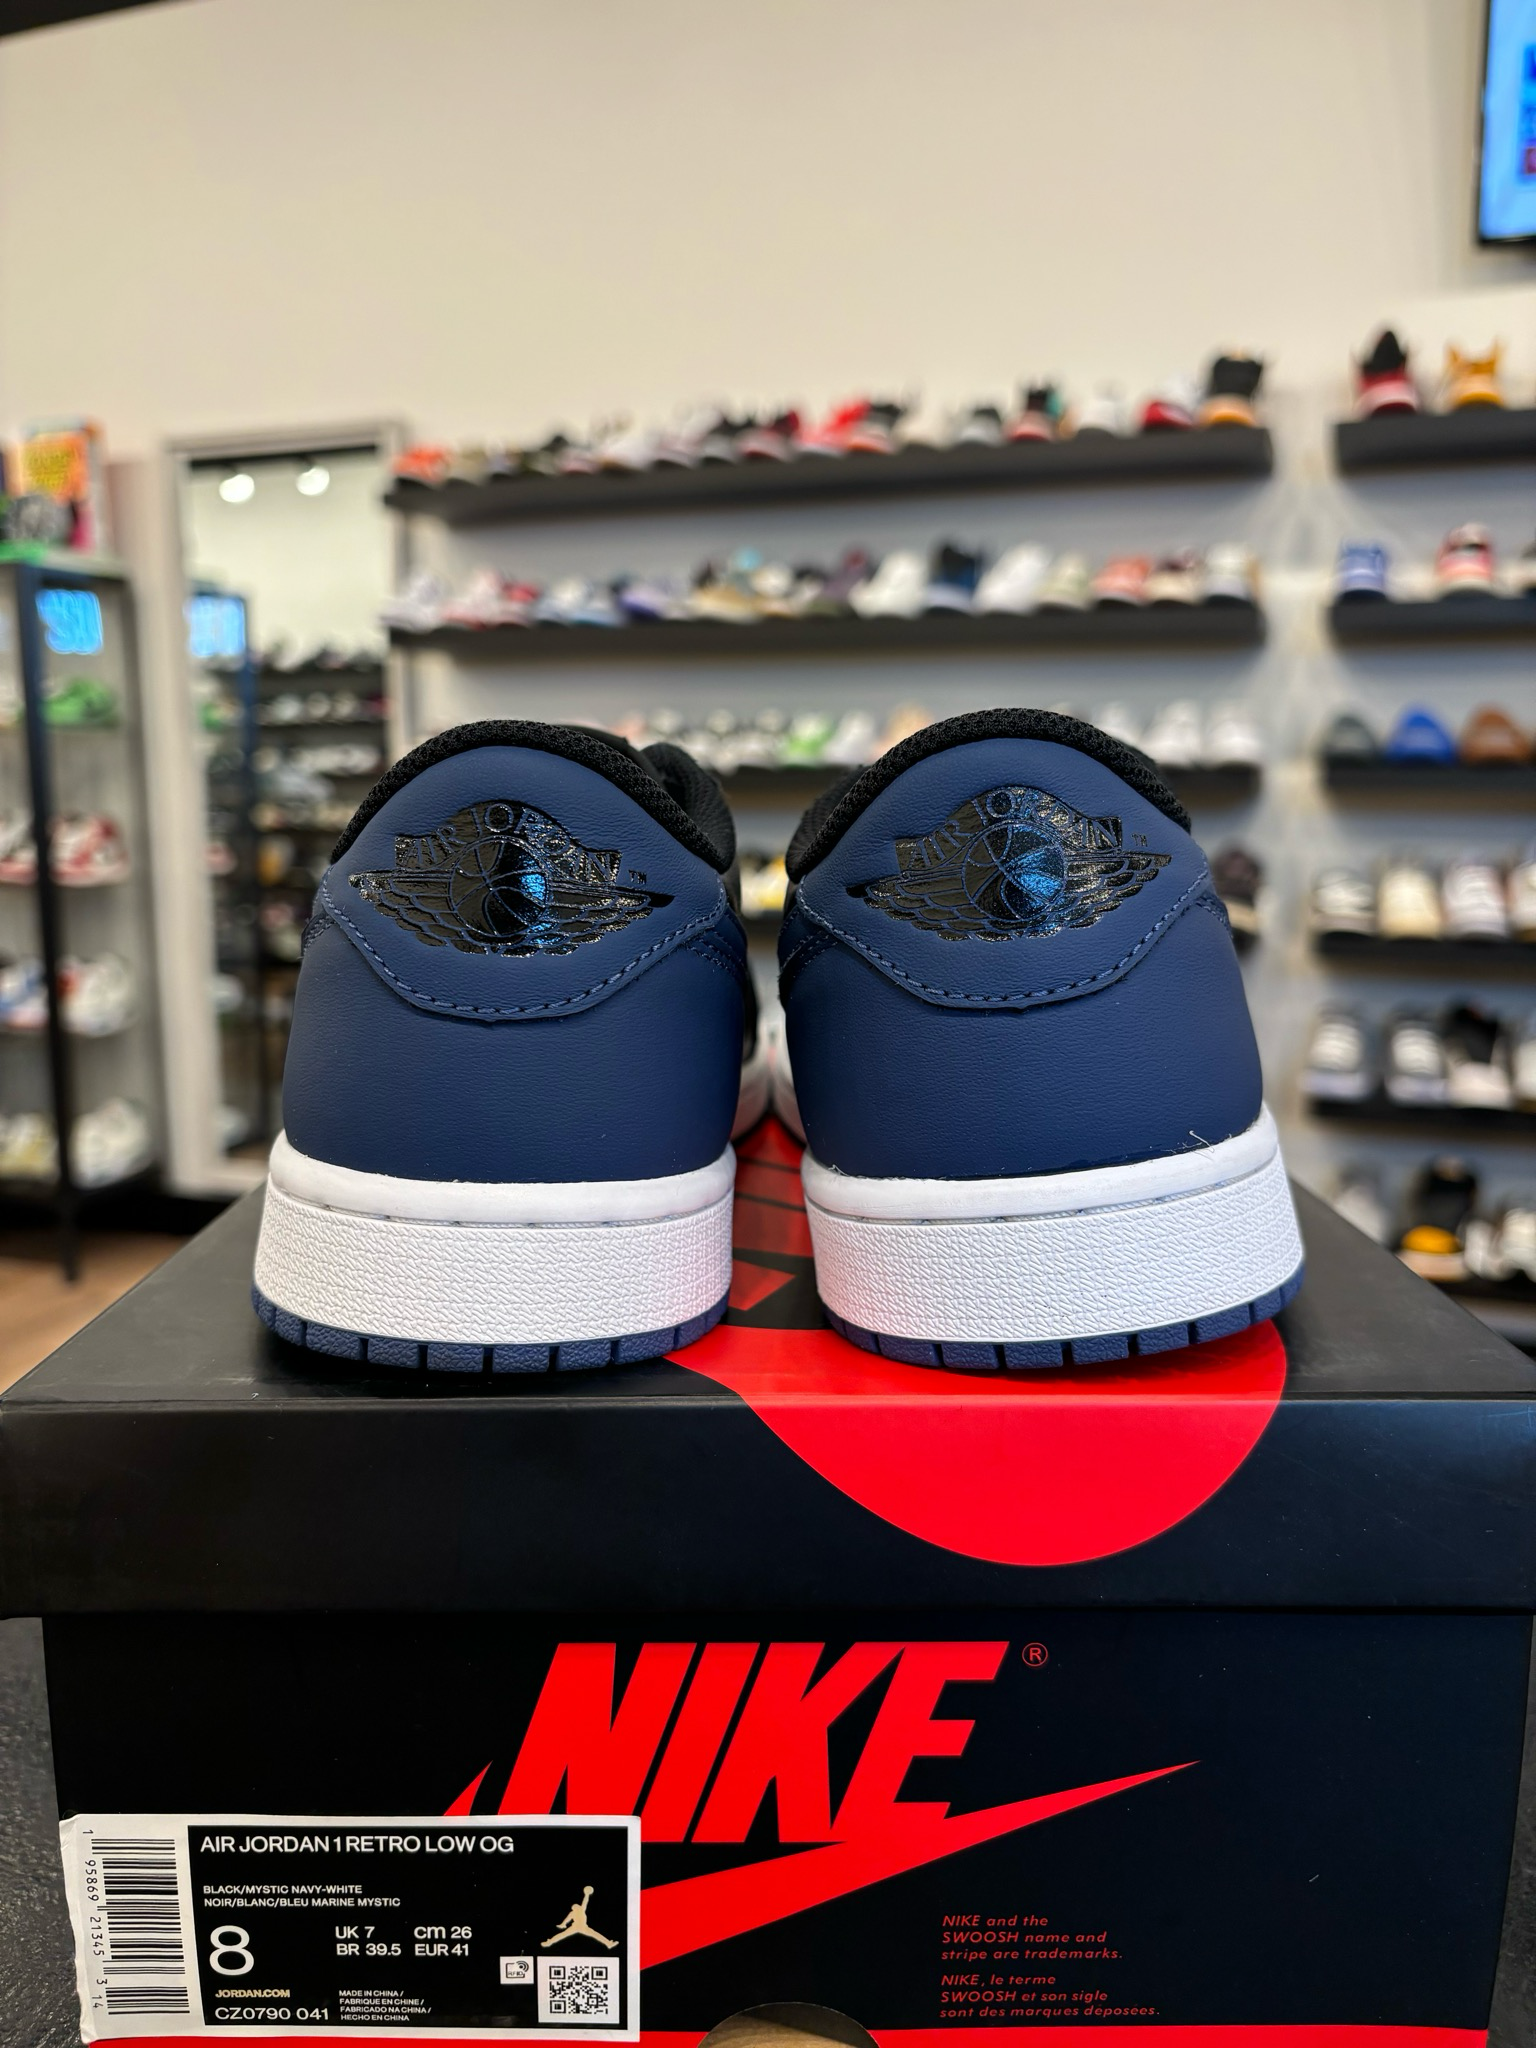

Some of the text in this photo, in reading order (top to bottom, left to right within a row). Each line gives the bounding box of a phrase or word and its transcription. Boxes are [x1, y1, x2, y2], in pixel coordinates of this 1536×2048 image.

[402, 825, 467, 868] AIR
[906, 819, 973, 869] AIR
[497, 1641, 1009, 1843] NIKE
[200, 1835, 515, 1853] AIR JORDAN 1 RETRO LOW OG
[85, 1859, 99, 1902] 95869
[202, 1885, 363, 1895] BLACK/MYSTIC NAVY-WHITE
[204, 1897, 401, 1908] NOIR/BLANC/BLEU MARINE MYSTIC
[942, 1914, 1049, 1927] NIKE and the
[89, 1916, 104, 1956] 21345
[335, 1926, 376, 1939] UK 7
[413, 1926, 473, 1940] cm 26
[942, 1931, 1107, 1944] SWOOSH name and
[209, 1924, 255, 1976] 8
[336, 1943, 402, 1956] BR 39.5
[414, 1943, 470, 1957] EUR 41
[941, 1947, 1123, 1962] stripe are trademarks.
[941, 1974, 1056, 1987] NIKE, le terme
[214, 1988, 291, 1998] JORDAN.COM
[338, 1989, 363, 1998] MADE
[364, 1990, 373, 1998] IN
[373, 1990, 399, 1998] CHINA
[941, 1990, 1108, 2004] SWOOSH et son sigle
[339, 1998, 381, 2007] FABRIQUE
[381, 1998, 394, 2007] EN
[394, 1998, 420, 2006] CHINE
[214, 2007, 329, 2021] CZ0790 041
[340, 2006, 388, 2014] FABRICADO
[388, 2006, 401, 2014] NA
[401, 2006, 427, 2014] CHINA
[940, 2004, 1160, 2018] sont des marques déposées.
[383, 2014, 410, 2022] CHINA
